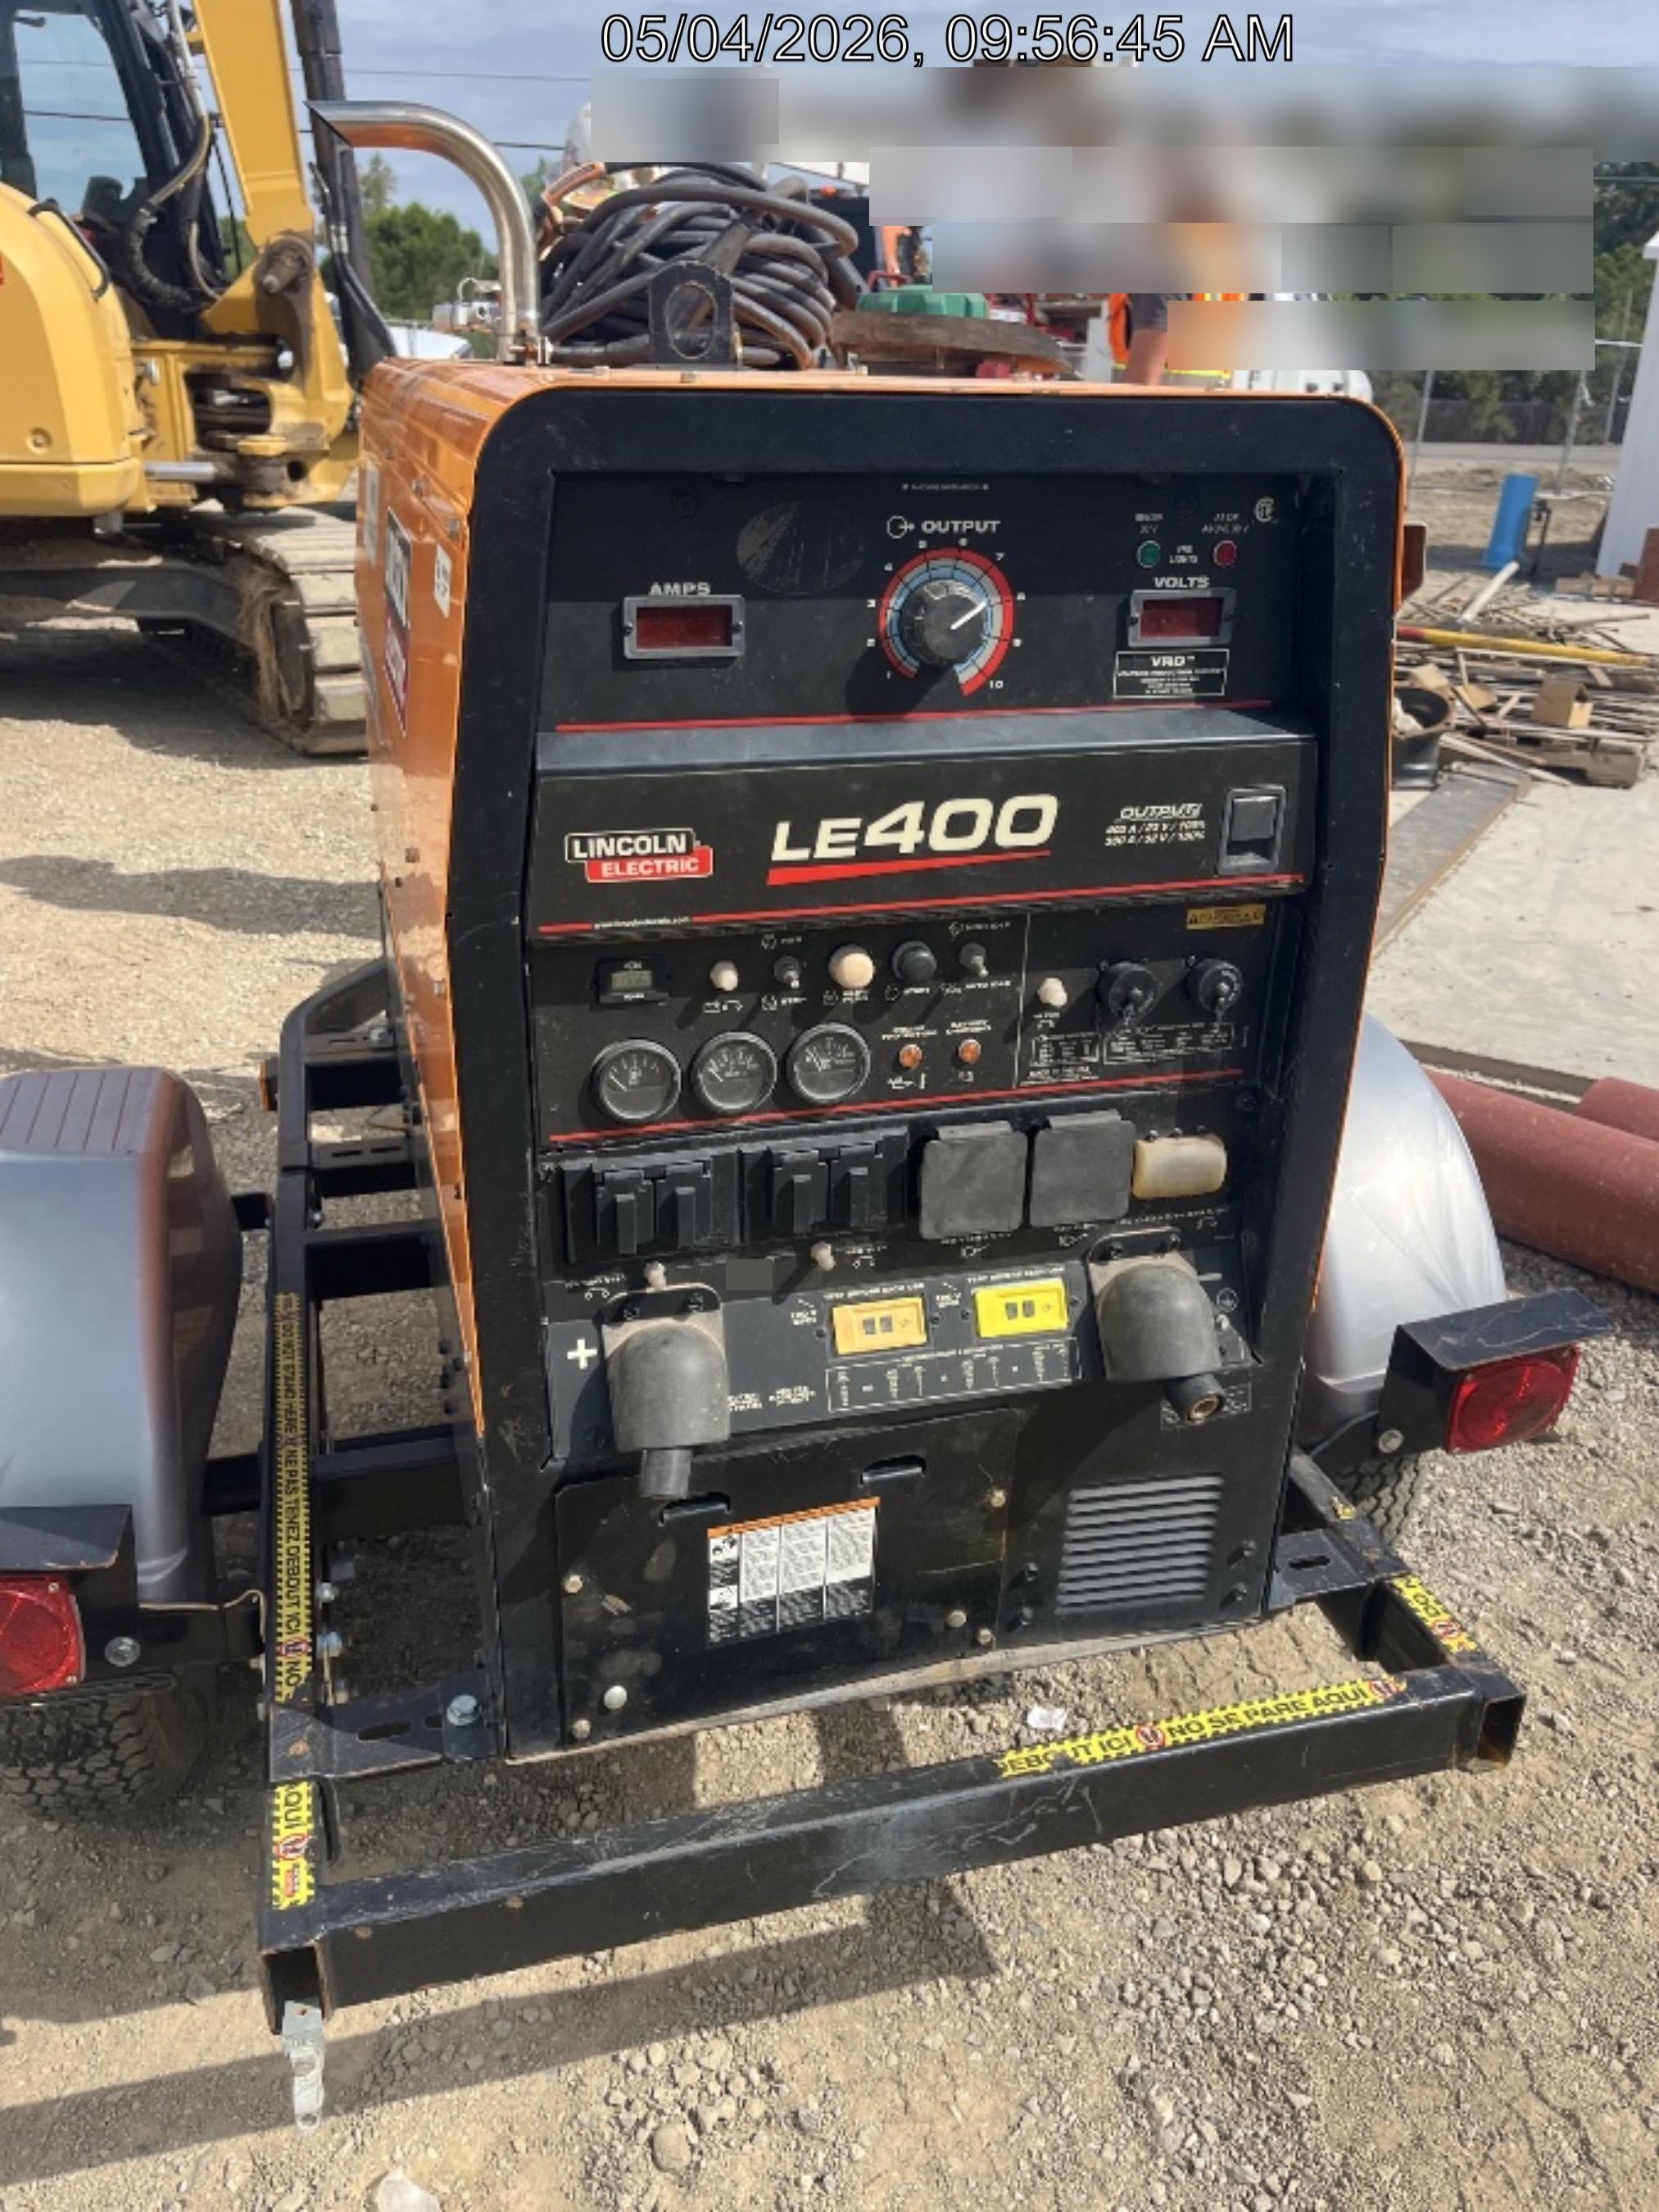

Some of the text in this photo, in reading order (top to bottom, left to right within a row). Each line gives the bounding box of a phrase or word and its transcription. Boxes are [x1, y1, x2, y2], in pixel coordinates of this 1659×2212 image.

[921, 521, 1001, 533] OUTPUT
[995, 552, 1005, 561] 7
[650, 582, 710, 596] AMPS
[1154, 576, 1210, 588] VOLTS
[1150, 655, 1185, 667] VRD
[990, 680, 1004, 689] 10
[771, 794, 1058, 861] LE400
[573, 832, 687, 857] LINCOLN
[601, 857, 699, 877] ELECTRIC
[283, 1363, 297, 1399] STAND
[284, 1403, 297, 1434] HERE
[285, 1449, 298, 1467] NE
[285, 1470, 299, 1495] PAS
[286, 1500, 300, 1543] TENEZ
[286, 1546, 301, 1608] DEBOUT
[285, 1660, 301, 1688] NO
[1168, 1689, 1368, 1738] NO SE PARE AQUI
[1099, 1736, 1131, 1756] ICI
[284, 1784, 303, 1829] QUI
